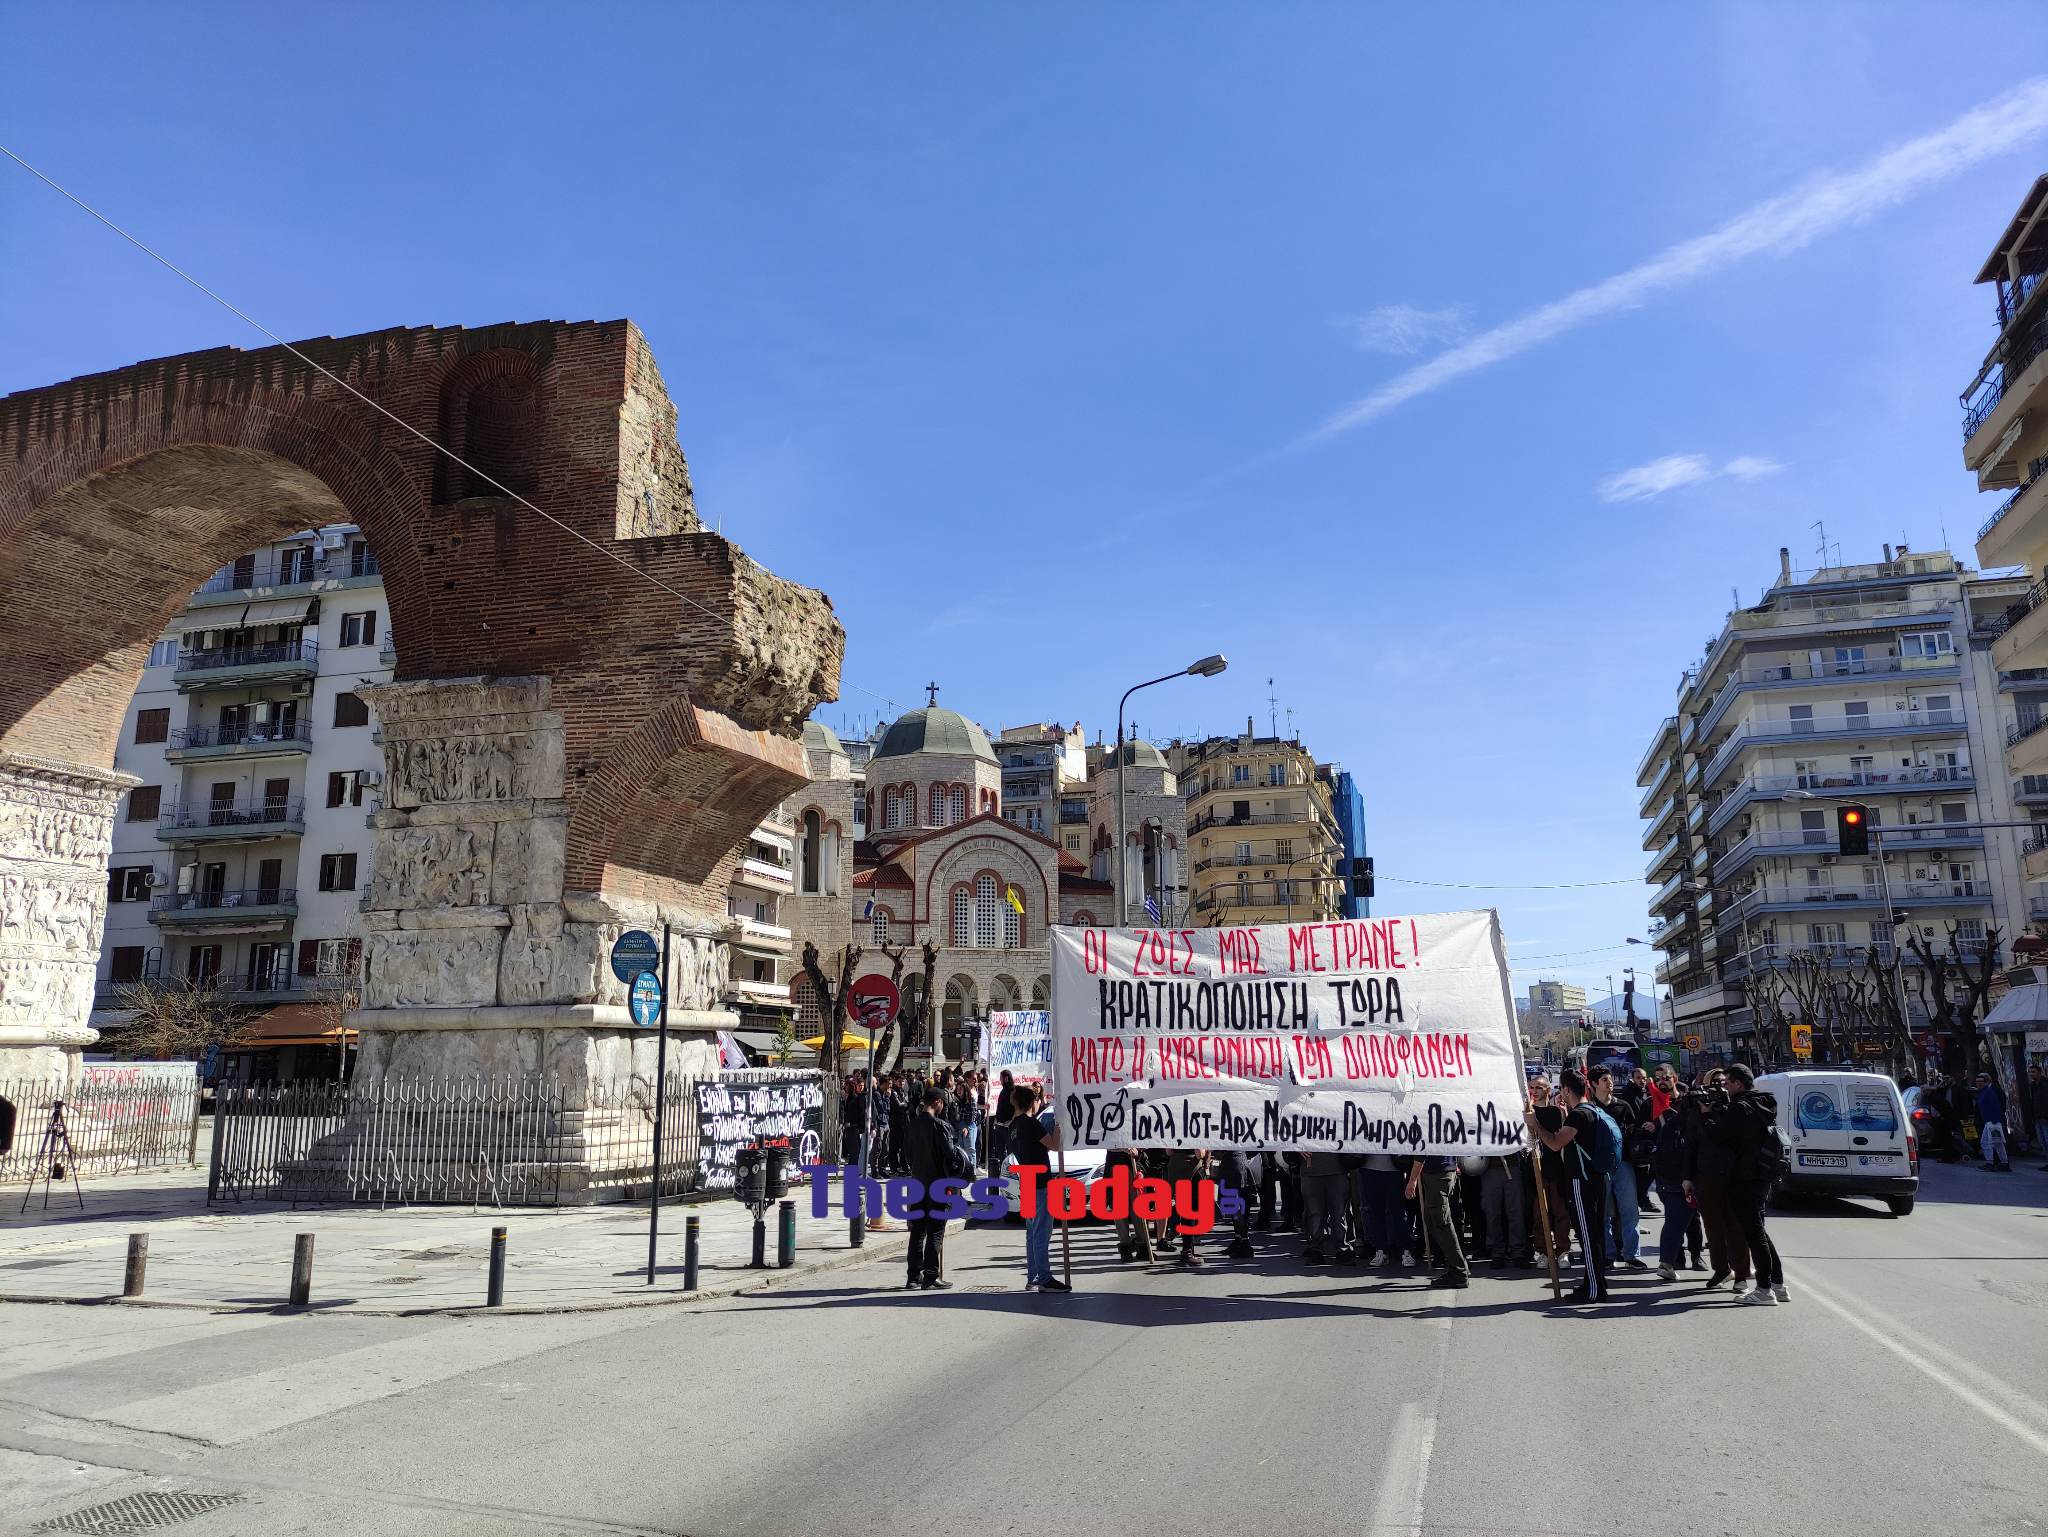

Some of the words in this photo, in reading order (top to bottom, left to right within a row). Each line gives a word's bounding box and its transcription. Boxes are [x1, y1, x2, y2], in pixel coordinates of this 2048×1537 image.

[1084, 929, 1107, 975] ΟΙ
[1133, 929, 1196, 976] ΖΩΕΣ
[1218, 928, 1267, 975] ΜΑΣ
[1288, 919, 1421, 973] ΜΕΤΡΑΝΕ!
[1098, 978, 1308, 1032] ΚΡΑΤΙΚΟΠΟΙΗΣΗ
[1327, 976, 1405, 1027] ΤΩΡΑ
[1071, 1036, 1125, 1085] ΚΑΤΩ
[1158, 1036, 1284, 1081] ΚΥΒΕΡΝΗΣΗ
[1292, 1035, 1333, 1080] ΤΩΝ
[1342, 1032, 1473, 1080] ΔΟΛΟΦΟΝΩΝ
